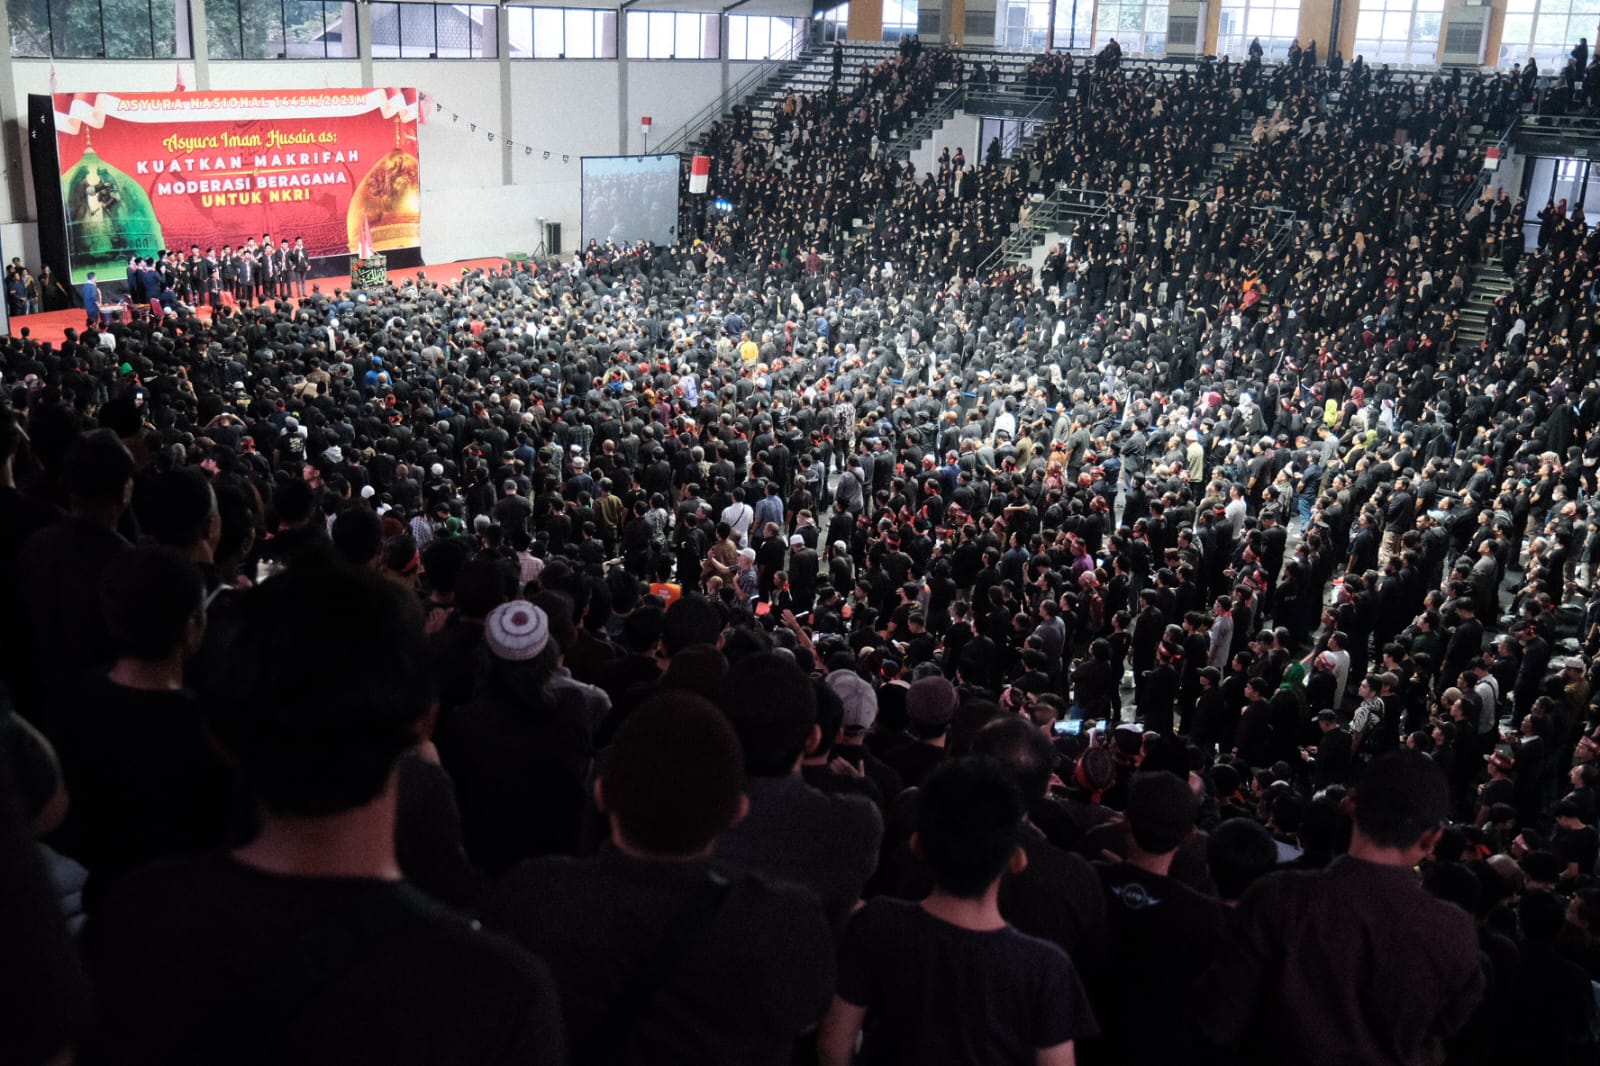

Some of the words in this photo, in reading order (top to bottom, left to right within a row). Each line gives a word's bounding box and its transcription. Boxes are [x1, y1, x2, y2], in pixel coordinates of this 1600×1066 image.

[117, 98, 184, 111] ASYURA
[190, 96, 269, 110] NASIONAL
[163, 133, 218, 153] Asyura
[220, 131, 262, 148] Imam
[265, 128, 315, 150] Husain
[137, 156, 242, 174] KUATKAN
[254, 149, 359, 167] MAKRIFAH
[158, 179, 251, 195] MODERASI
[257, 172, 346, 189] BERAGAMA
[202, 195, 261, 207] UNTUK
[269, 188, 311, 203] NKRI
